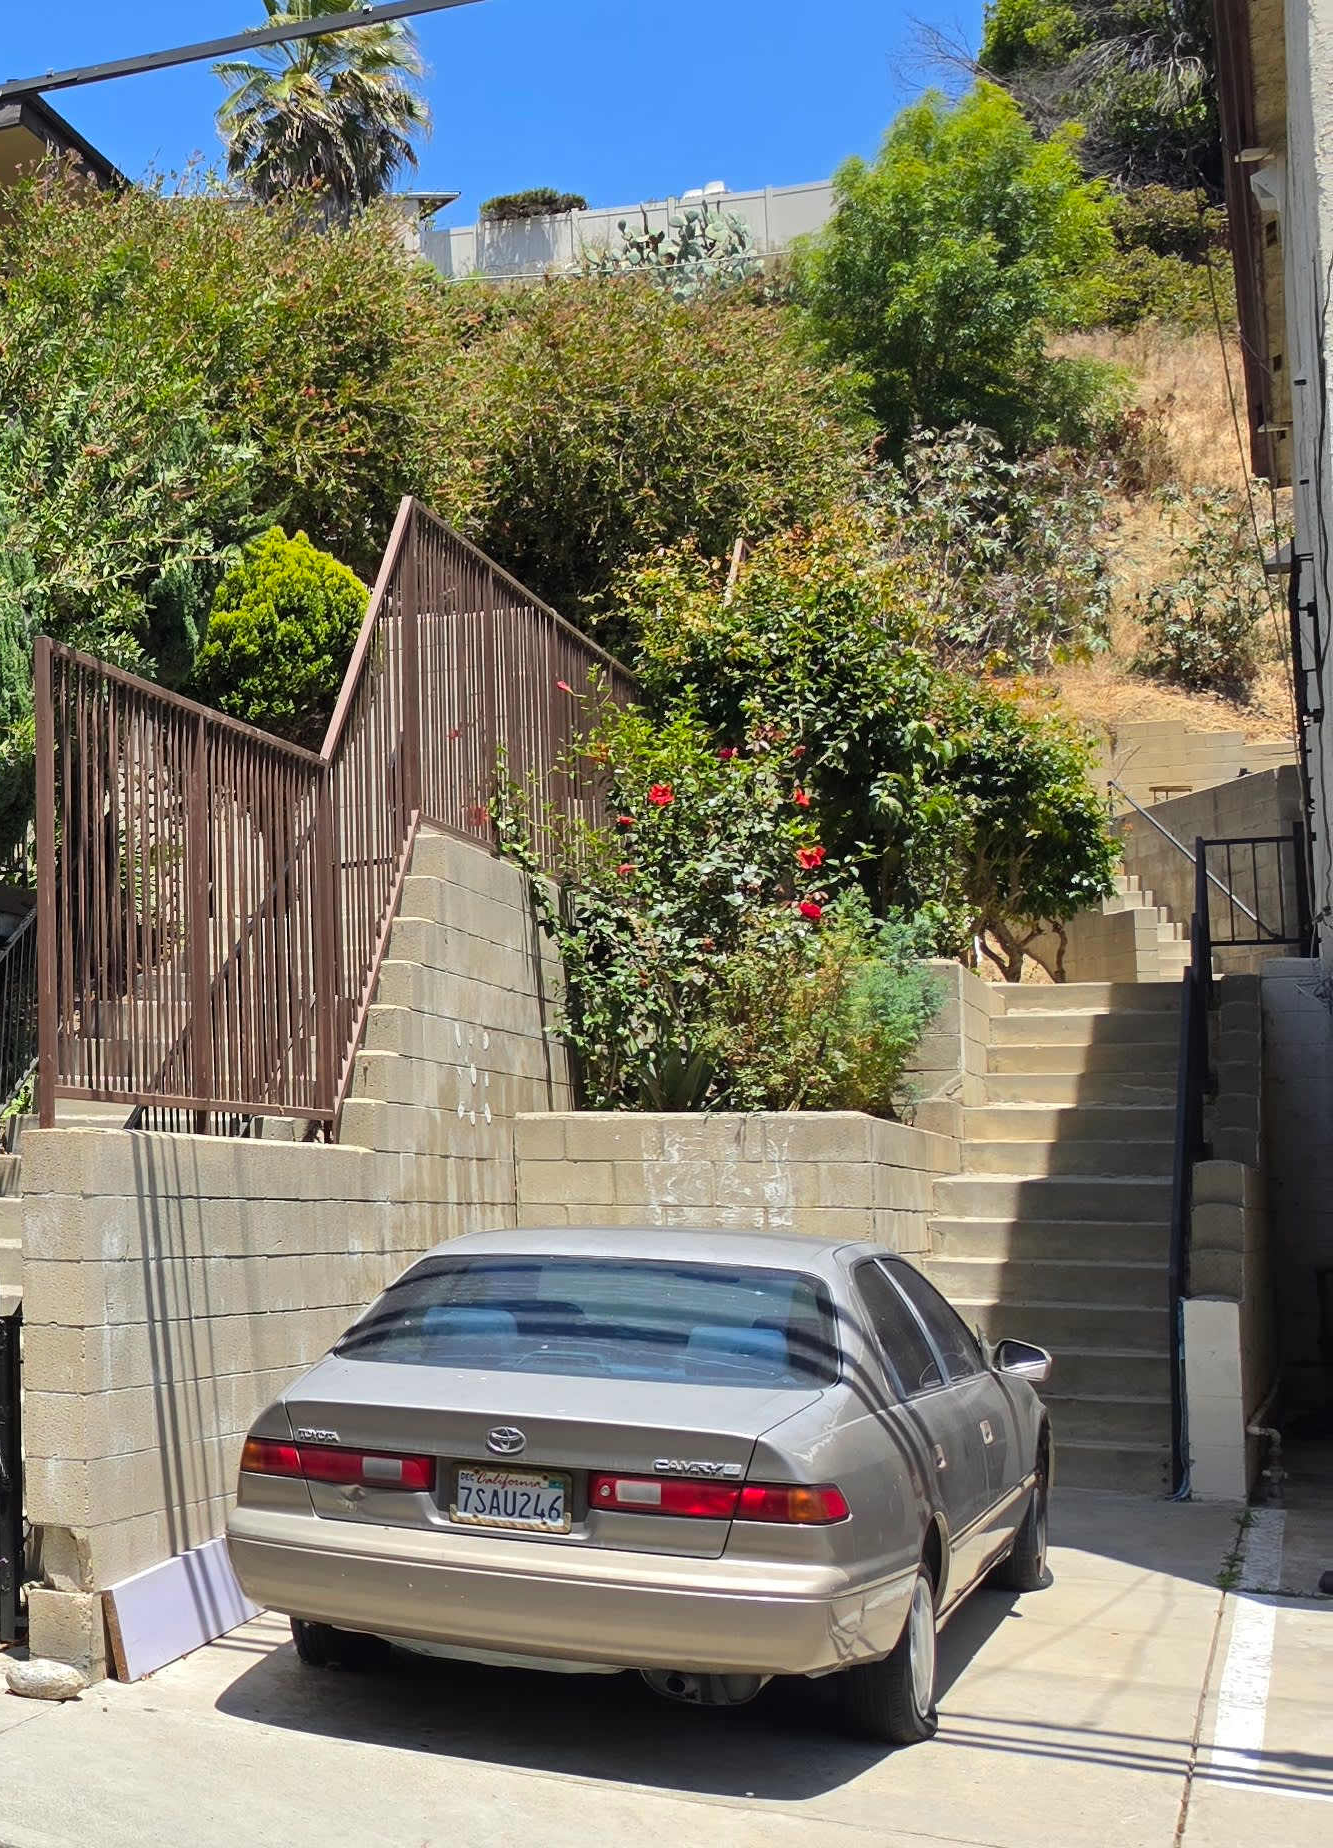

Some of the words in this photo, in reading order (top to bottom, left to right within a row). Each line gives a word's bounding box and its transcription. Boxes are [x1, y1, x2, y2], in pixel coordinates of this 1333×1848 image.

[298, 1427, 341, 1443] TOYOTA
[653, 1457, 724, 1475] CAMRY
[460, 1471, 474, 1481] DEC
[475, 1472, 543, 1489] California
[460, 1485, 562, 1523] 7SAU246
